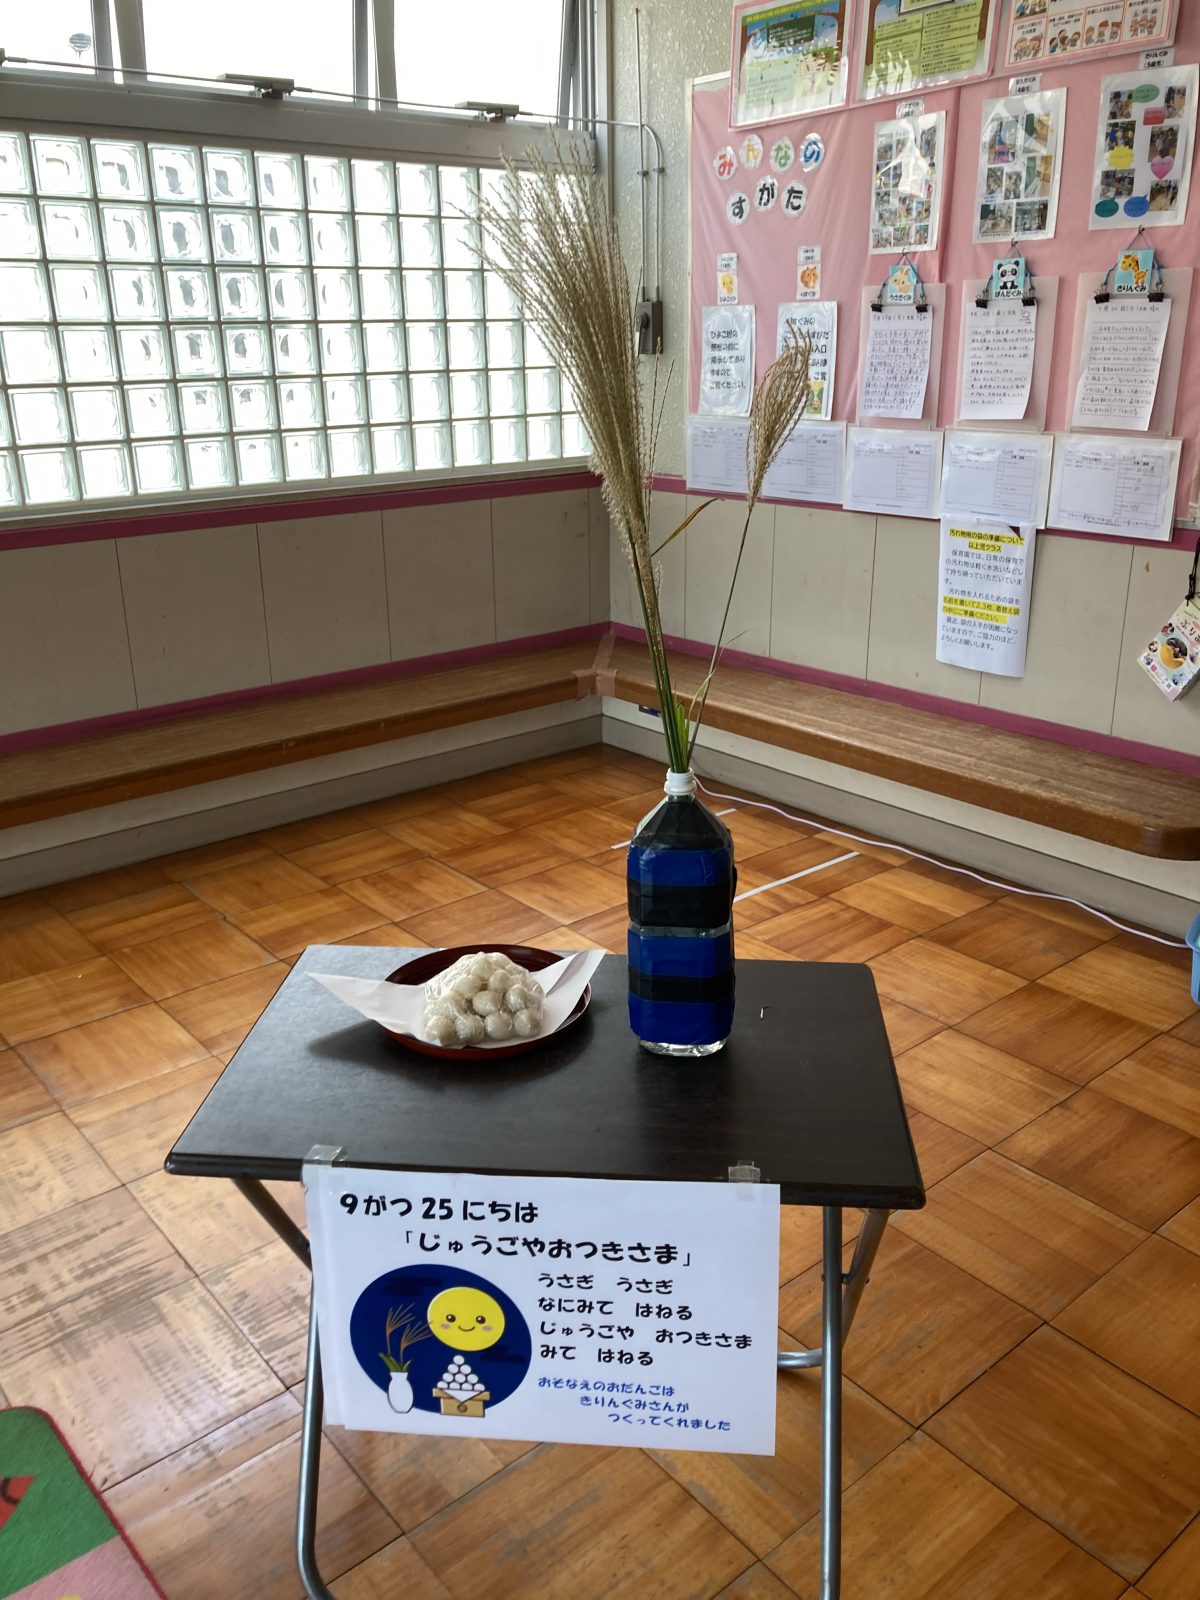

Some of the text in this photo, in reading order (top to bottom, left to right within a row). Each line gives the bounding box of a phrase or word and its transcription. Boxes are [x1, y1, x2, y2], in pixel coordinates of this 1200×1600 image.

[717, 138, 822, 177] みんなの
[731, 182, 804, 219] すがた
[994, 290, 1023, 298] ぱんだぐみ
[1116, 284, 1147, 293] きりんぐみ
[405, 1230, 691, 1266] 「じゅうごやおつきさま」
[538, 1273, 673, 1295] うさぎ うさぎ
[538, 1297, 693, 1321] なにみて はねる
[540, 1321, 753, 1349] じゅうごや おつきさま
[540, 1344, 654, 1366] みて はねる
[538, 1376, 676, 1397] おそなえのおだんごは
[580, 1395, 690, 1413] きりんぐみさんが
[608, 1412, 731, 1431] つくってくれました
